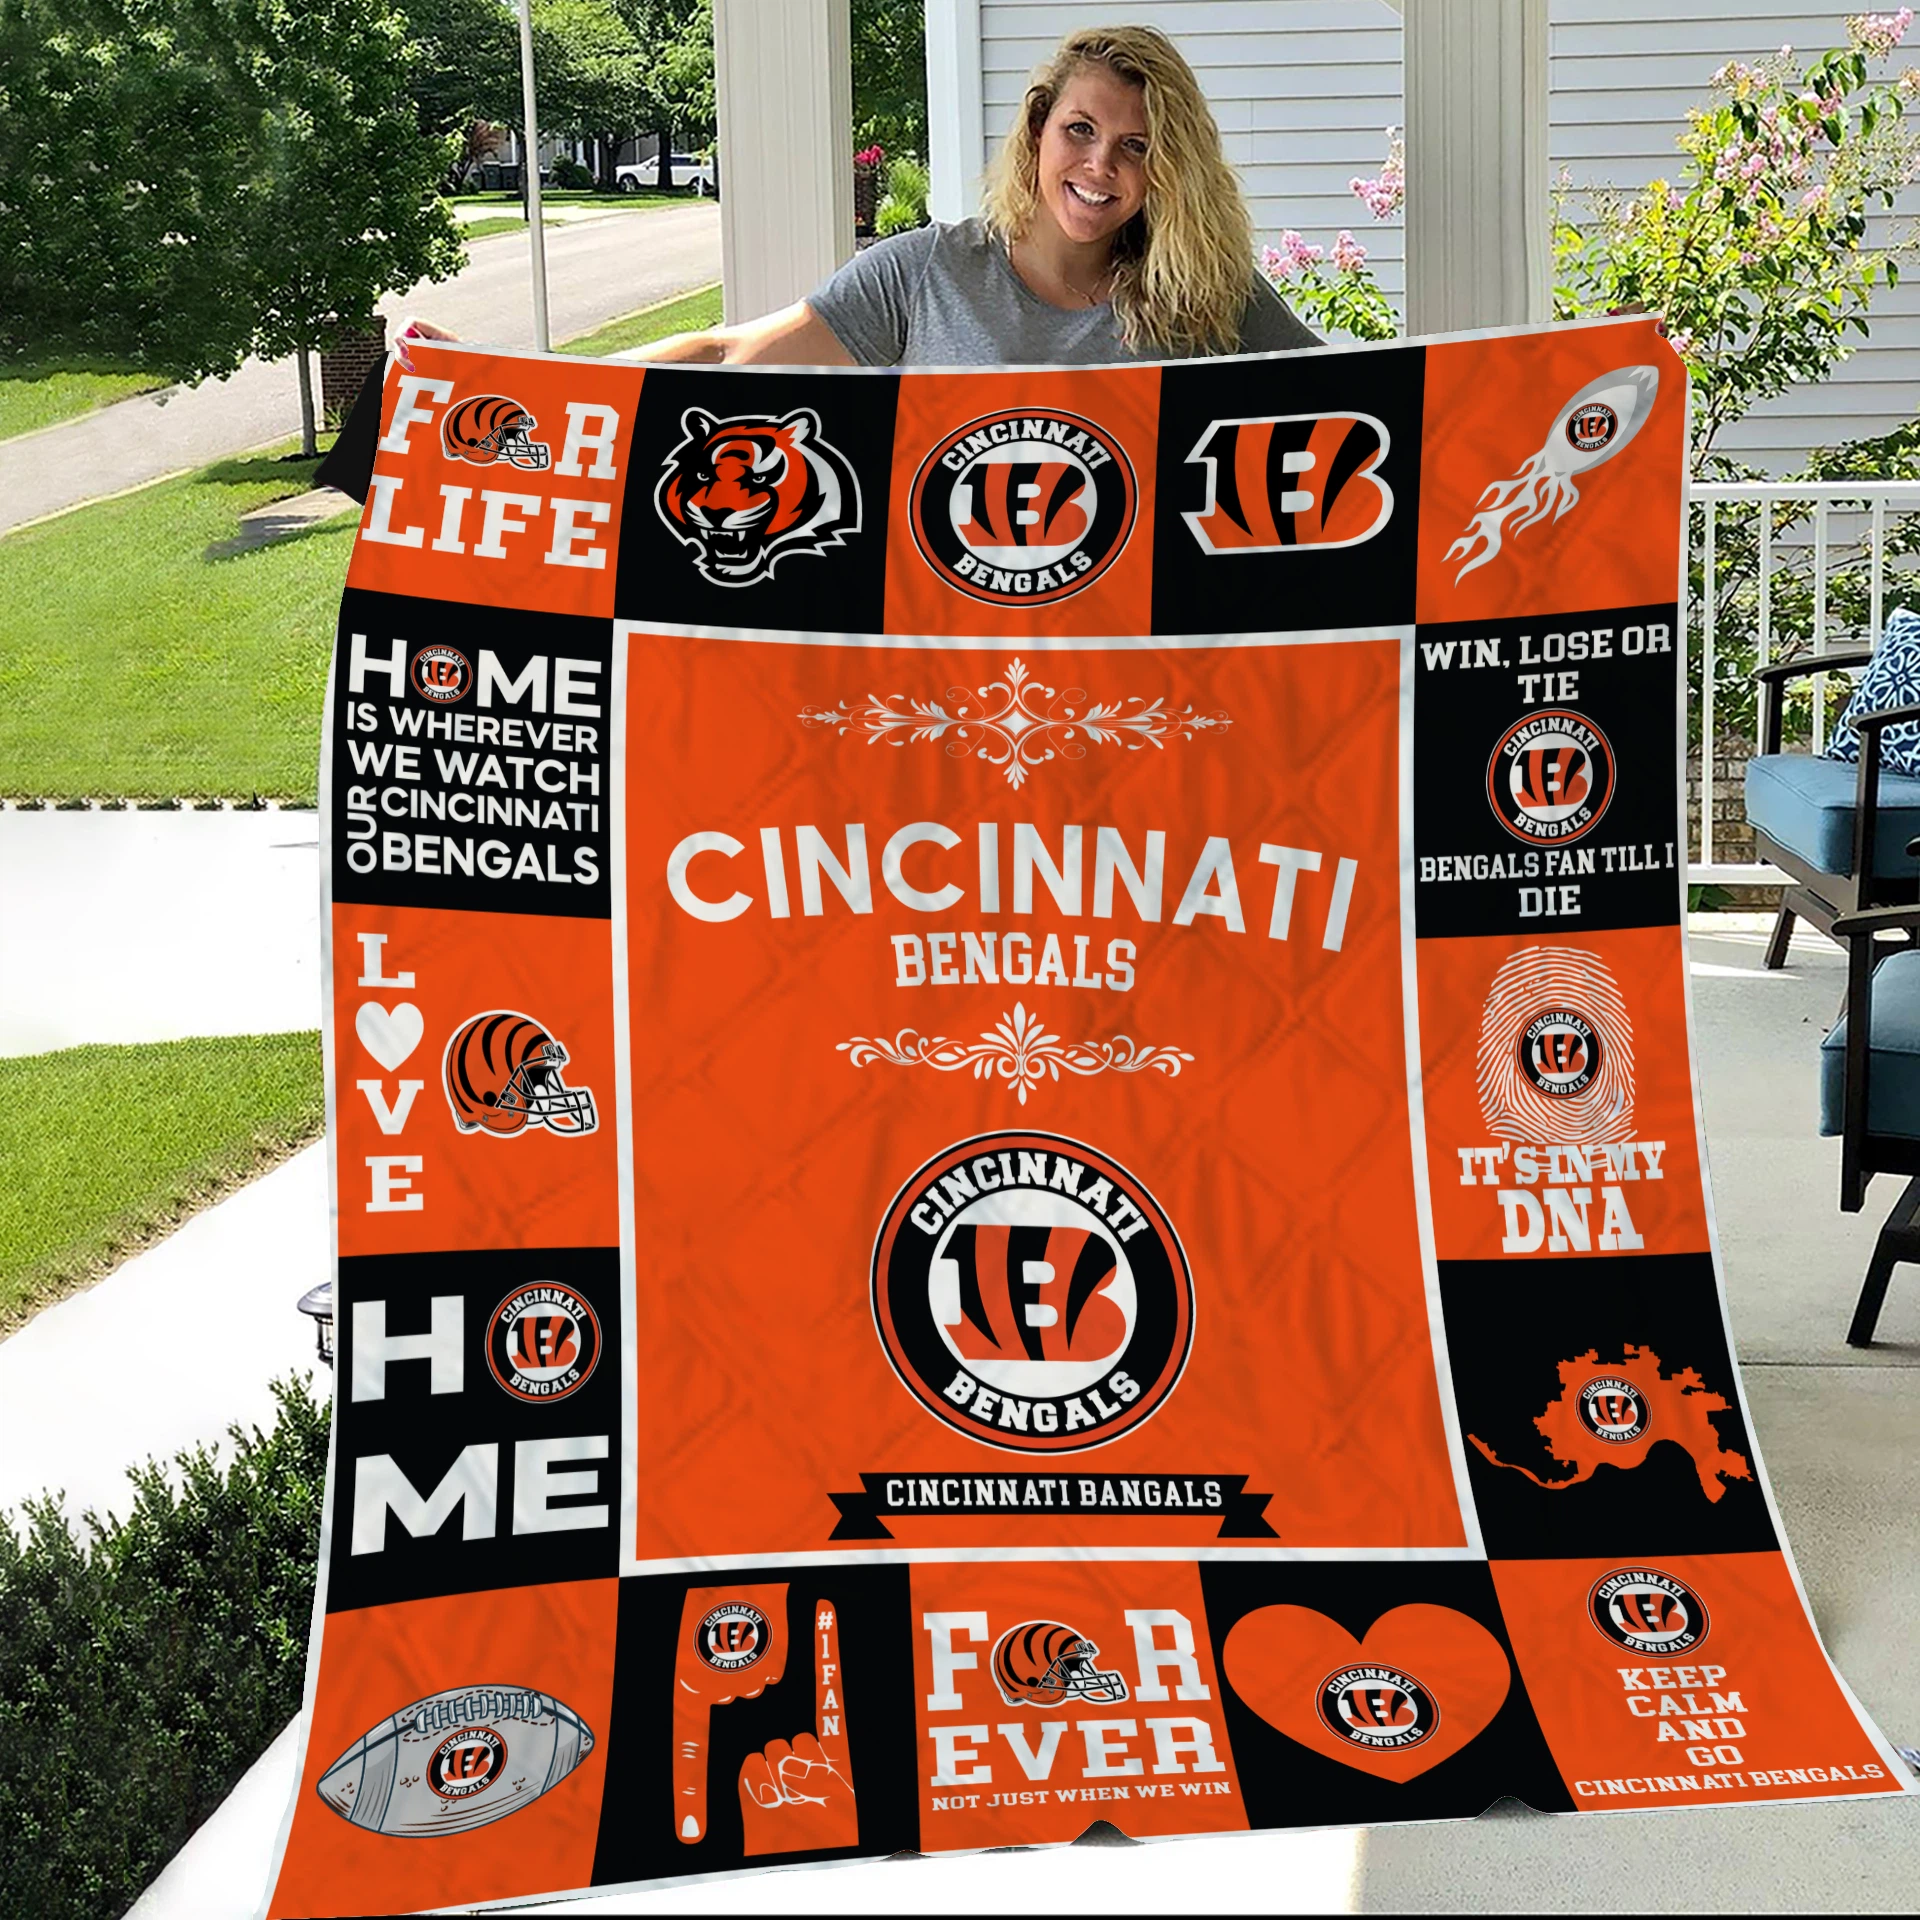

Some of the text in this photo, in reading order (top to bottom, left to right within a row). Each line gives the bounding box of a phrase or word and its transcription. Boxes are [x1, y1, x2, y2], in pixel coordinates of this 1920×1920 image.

[1573, 406, 1612, 421] CINCINNATI
[942, 419, 1112, 472] CINCINNATI
[1576, 437, 1608, 449] BENGALS
[361, 474, 611, 569] LIFE
[954, 550, 1093, 593] BENGALS
[420, 648, 465, 667] CINCINNATI
[1420, 623, 1671, 671] WIN, LOSE OR
[423, 688, 460, 699] BENGALS
[1518, 671, 1579, 704] TIE
[347, 701, 598, 753] IS WHEREVER
[1503, 717, 1600, 757] CINCINNATI
[347, 739, 600, 796] WE WATCH
[381, 787, 598, 832] CINCINNATI
[1514, 807, 1592, 837] BENGALS
[347, 785, 377, 874] OUR
[383, 831, 600, 884] BENGALS
[1420, 843, 1674, 882] BENGALS FAN TILL I
[667, 821, 1359, 952] CINCINNATI
[1519, 885, 1581, 917] DIE
[890, 931, 1137, 992] BENGALS
[1526, 1012, 1591, 1040] CINCINNATI
[1536, 1074, 1589, 1094] BENGALS
[1458, 1141, 1666, 1185] IT'S IN MY
[910, 1152, 1149, 1243] CINCINNATI
[1497, 1186, 1644, 1253] DNA
[500, 1289, 587, 1323] CINCINNATI
[510, 1368, 580, 1395] BENGALS
[1582, 1379, 1639, 1400] CINCINNATI
[943, 1371, 1141, 1432] BENGALS
[1596, 1425, 1641, 1441] BENGALS
[886, 1480, 1222, 1507] CINCINNATI BANGALS
[1598, 1572, 1686, 1599] CINCINNATI
[704, 1605, 763, 1627] CINCINNATI
[1623, 1632, 1695, 1653] BENGALS
[709, 1652, 758, 1668] BENGALS
[1327, 1669, 1418, 1694] CINCINNATI
[1617, 1665, 1727, 1690] KEEP
[1626, 1691, 1748, 1717] CALM
[440, 1731, 500, 1755] CINCINNATI
[1350, 1726, 1424, 1747] BENGALS
[1657, 1717, 1746, 1742] AND
[929, 1717, 1226, 1787] EVER
[1685, 1745, 1744, 1767] GO
[439, 1777, 490, 1796] BENGALS
[1574, 1763, 1885, 1797] CINCINNATI BENGALS
[931, 1781, 1231, 1811] NOT JUST WHEN WE WIN
